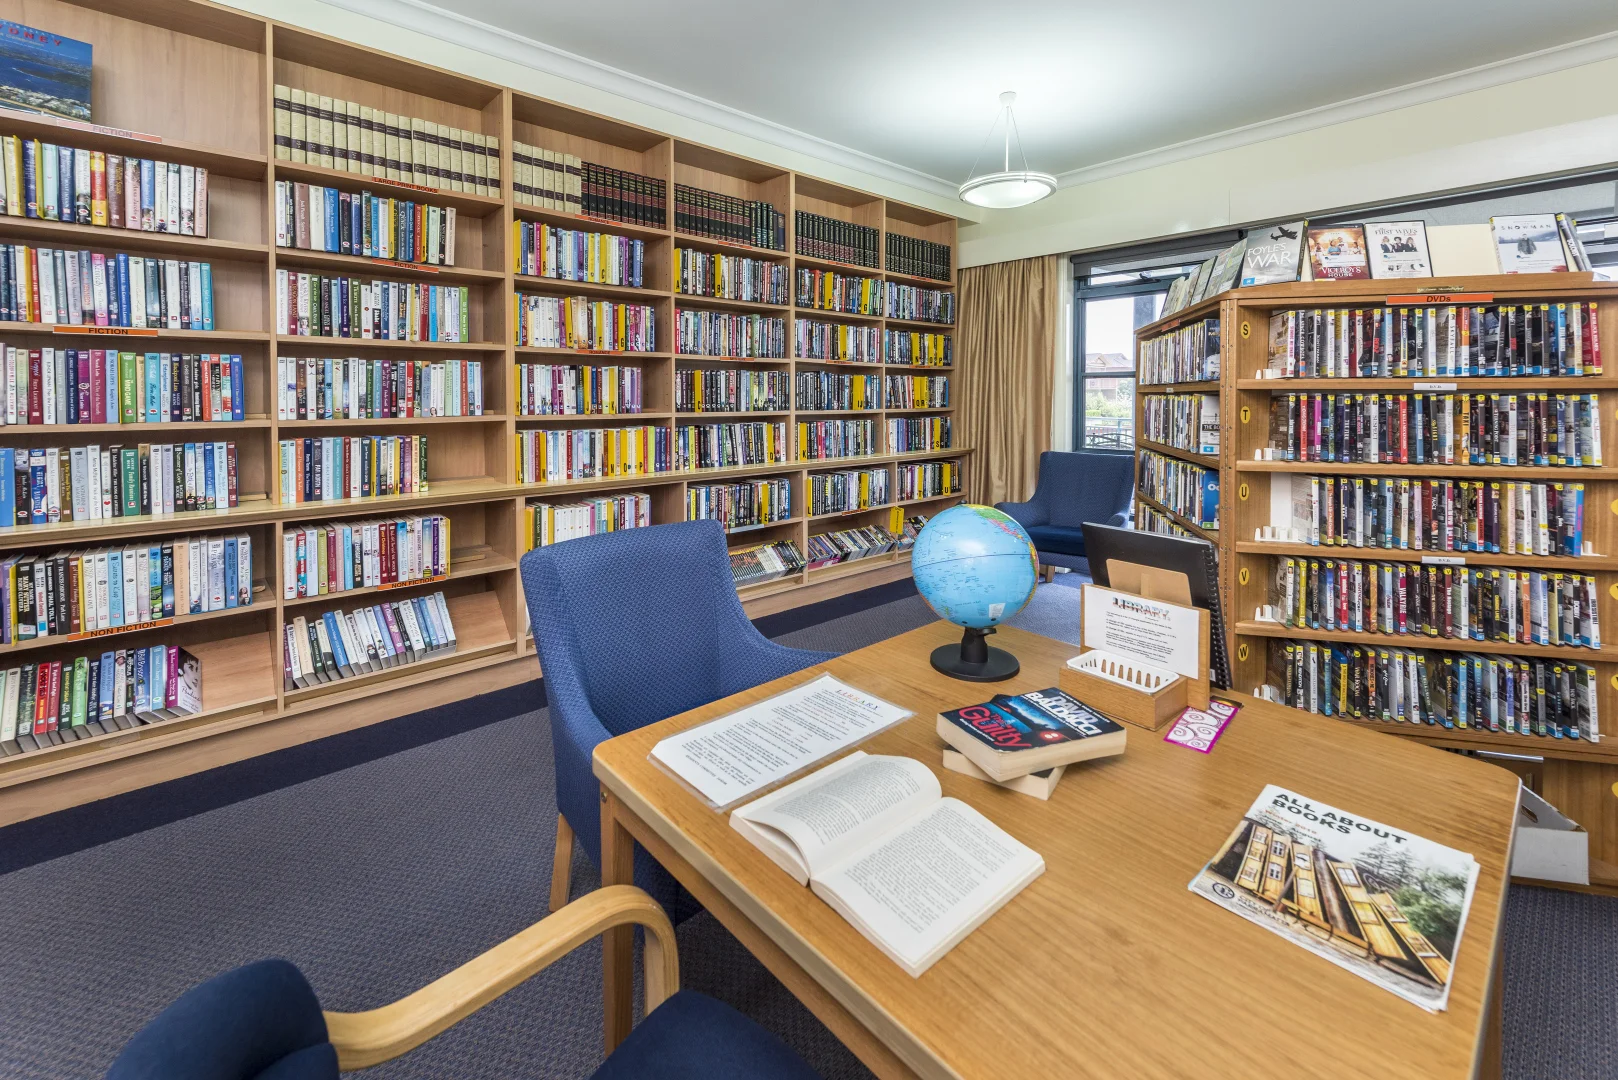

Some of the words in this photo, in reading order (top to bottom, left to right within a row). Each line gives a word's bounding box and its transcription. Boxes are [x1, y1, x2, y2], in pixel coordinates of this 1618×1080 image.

[93, 126, 132, 137] FICTION
[374, 178, 396, 186] LARGE
[416, 185, 438, 193] BOOKS
[1248, 242, 1286, 257] FOYLE'S
[394, 262, 418, 270] FICTION
[1248, 254, 1292, 268] WAR
[1321, 266, 1362, 275] VICEROY'S
[1243, 324, 1249, 335] S
[1242, 410, 1249, 420] T
[1242, 487, 1247, 496] U
[408, 577, 434, 586] FICTION
[1241, 571, 1247, 581] V
[91, 628, 114, 637] NON
[116, 621, 157, 633] FICTION
[1240, 646, 1248, 657] W
[835, 688, 880, 712] LIBRARY
[1026, 692, 1102, 736] BALDACCI
[1052, 695, 1099, 724] DAVID
[958, 706, 1032, 748] Guilty
[1272, 798, 1353, 834] BOOKS
[1276, 792, 1316, 814] ALL
[1323, 812, 1408, 844] ABOUT
